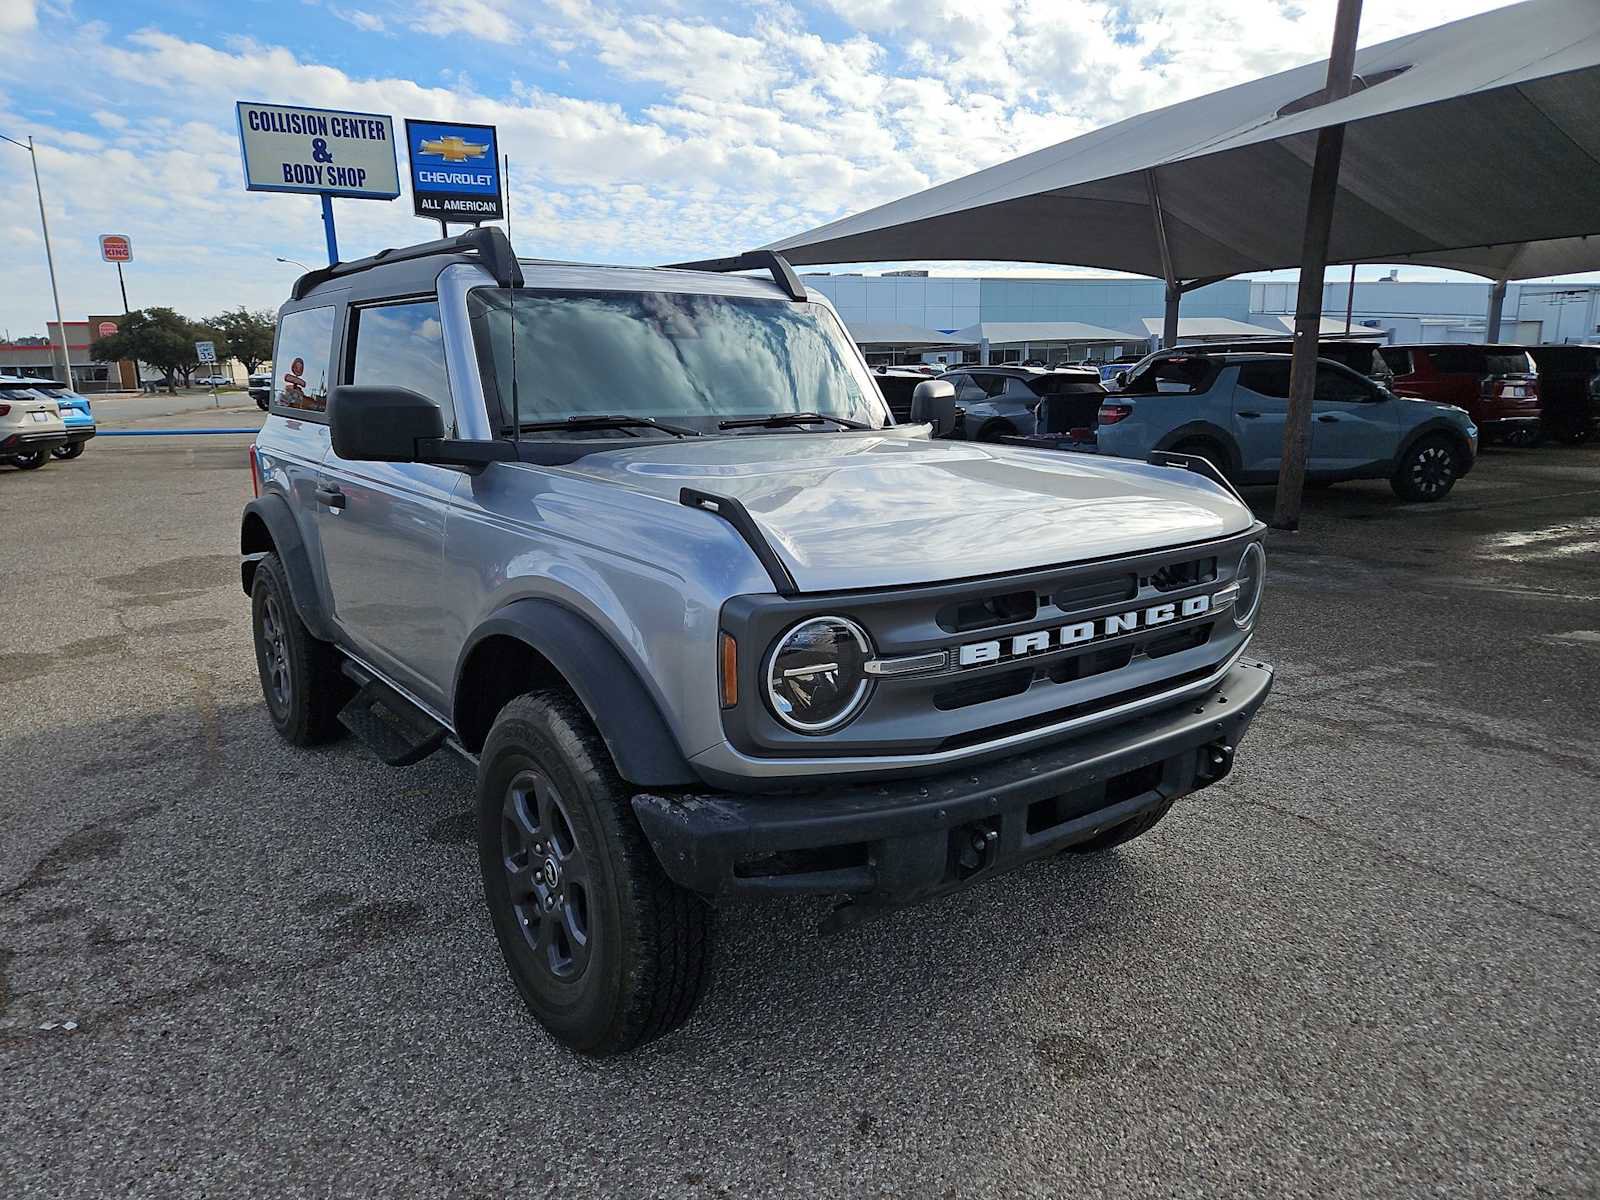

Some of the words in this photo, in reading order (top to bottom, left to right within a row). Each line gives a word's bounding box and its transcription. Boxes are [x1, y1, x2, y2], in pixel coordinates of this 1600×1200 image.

[248, 110, 328, 136] COLLISION
[331, 117, 386, 141] CENTER
[312, 138, 333, 164] &
[282, 163, 323, 185] BODY
[326, 166, 366, 187] SHOP
[419, 171, 492, 186] CHEVROLET
[421, 199, 442, 210] ALL
[444, 200, 497, 212] AMERICAN
[105, 248, 130, 257] KING
[200, 352, 214, 360] 35
[958, 594, 1210, 667] BRONCO
